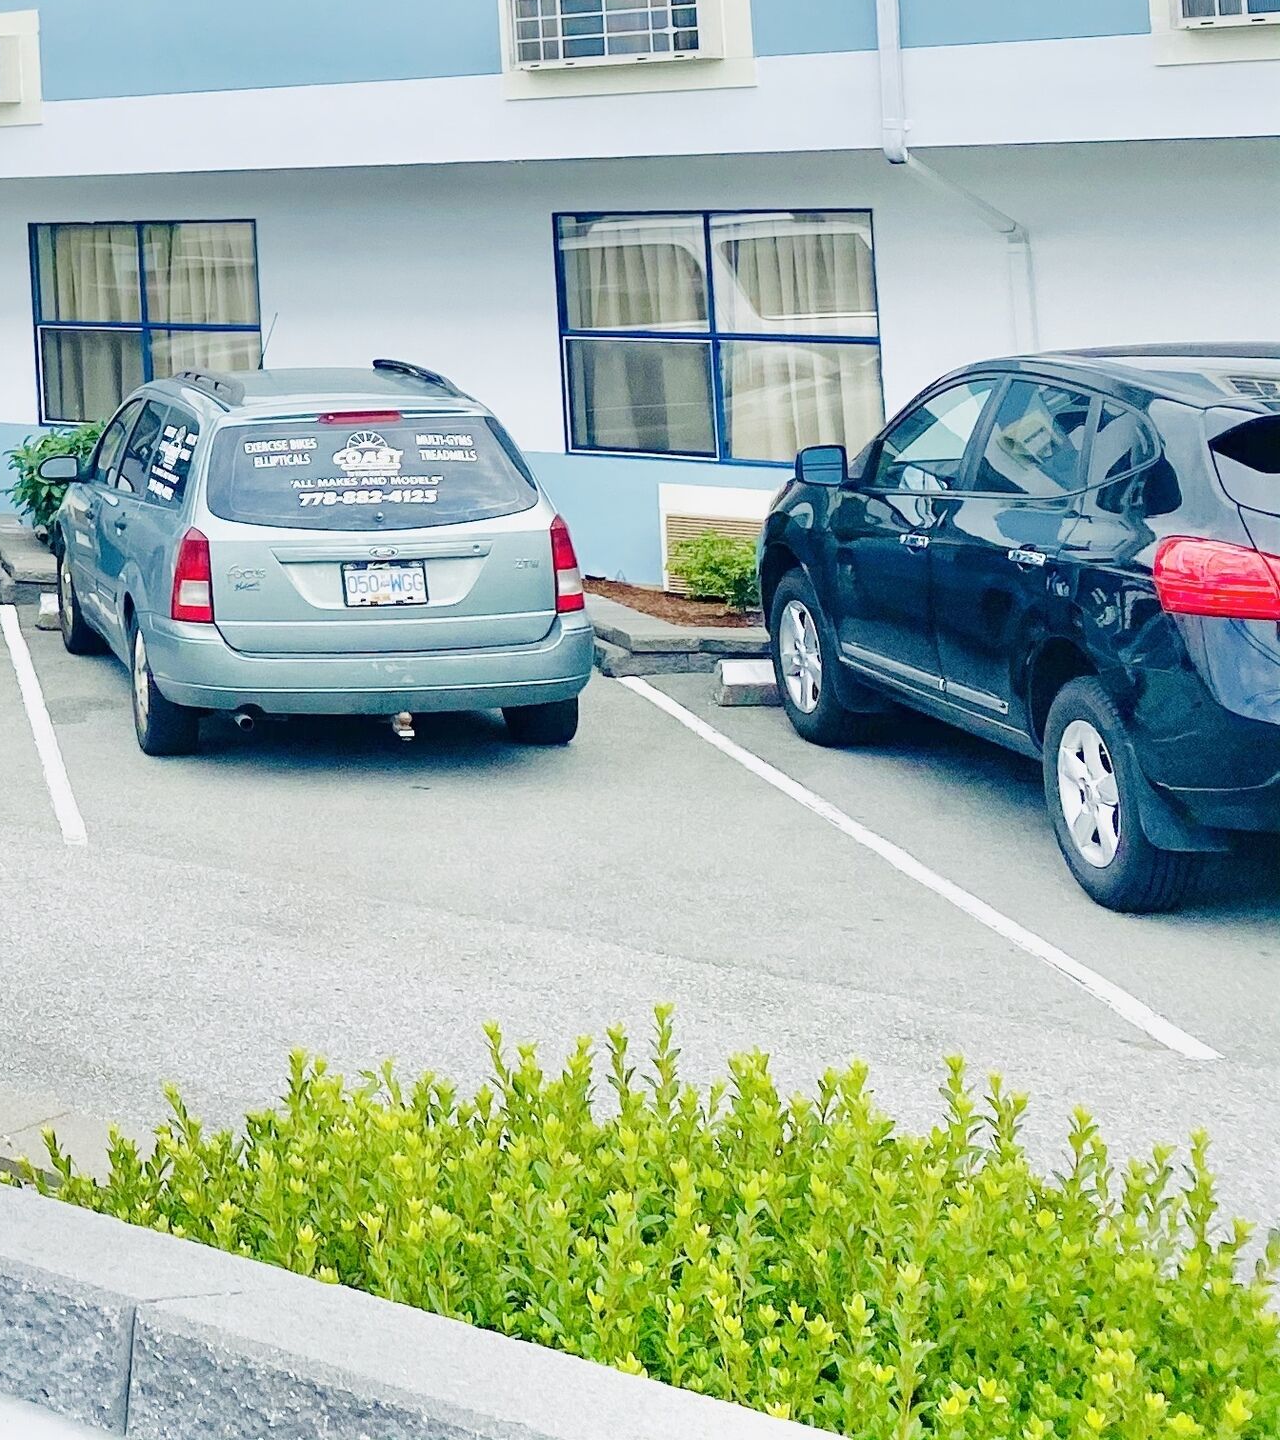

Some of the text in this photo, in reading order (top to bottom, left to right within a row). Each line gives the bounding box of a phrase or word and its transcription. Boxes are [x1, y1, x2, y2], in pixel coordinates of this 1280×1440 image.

[244, 438, 318, 454] EXERCISE BIKES
[415, 434, 474, 446] MULTI-GYMS
[254, 453, 312, 468] ELLIPTICALS
[333, 447, 404, 465] COAST
[418, 449, 478, 461] TREADMILLS
[317, 477, 358, 488] MAKES
[361, 476, 387, 486] AND
[298, 489, 438, 507] 778-882-4125
